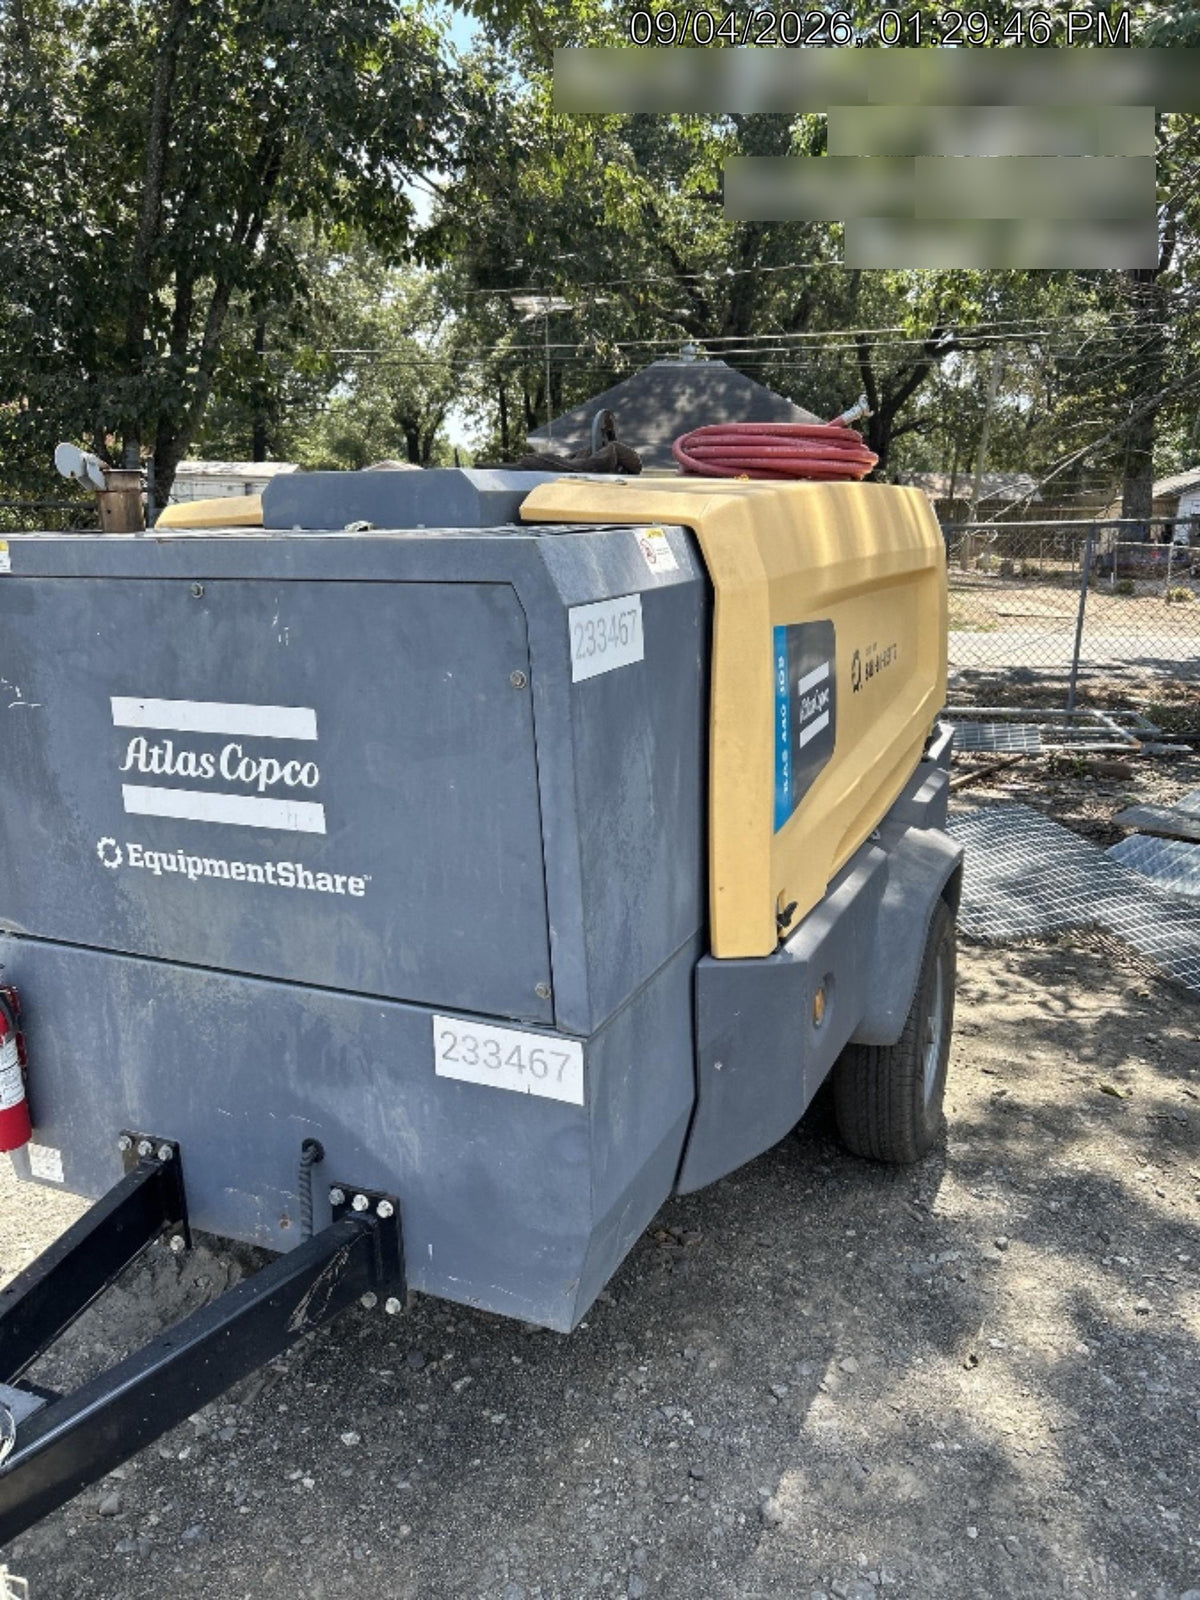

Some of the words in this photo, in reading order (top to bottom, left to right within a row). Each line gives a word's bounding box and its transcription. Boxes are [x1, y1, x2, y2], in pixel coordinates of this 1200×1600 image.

[573, 609, 638, 660] 233467
[119, 736, 215, 779] Atlas
[219, 743, 320, 791] Copco
[126, 842, 366, 897] EquipmentShare
[440, 1031, 571, 1082] 233467
